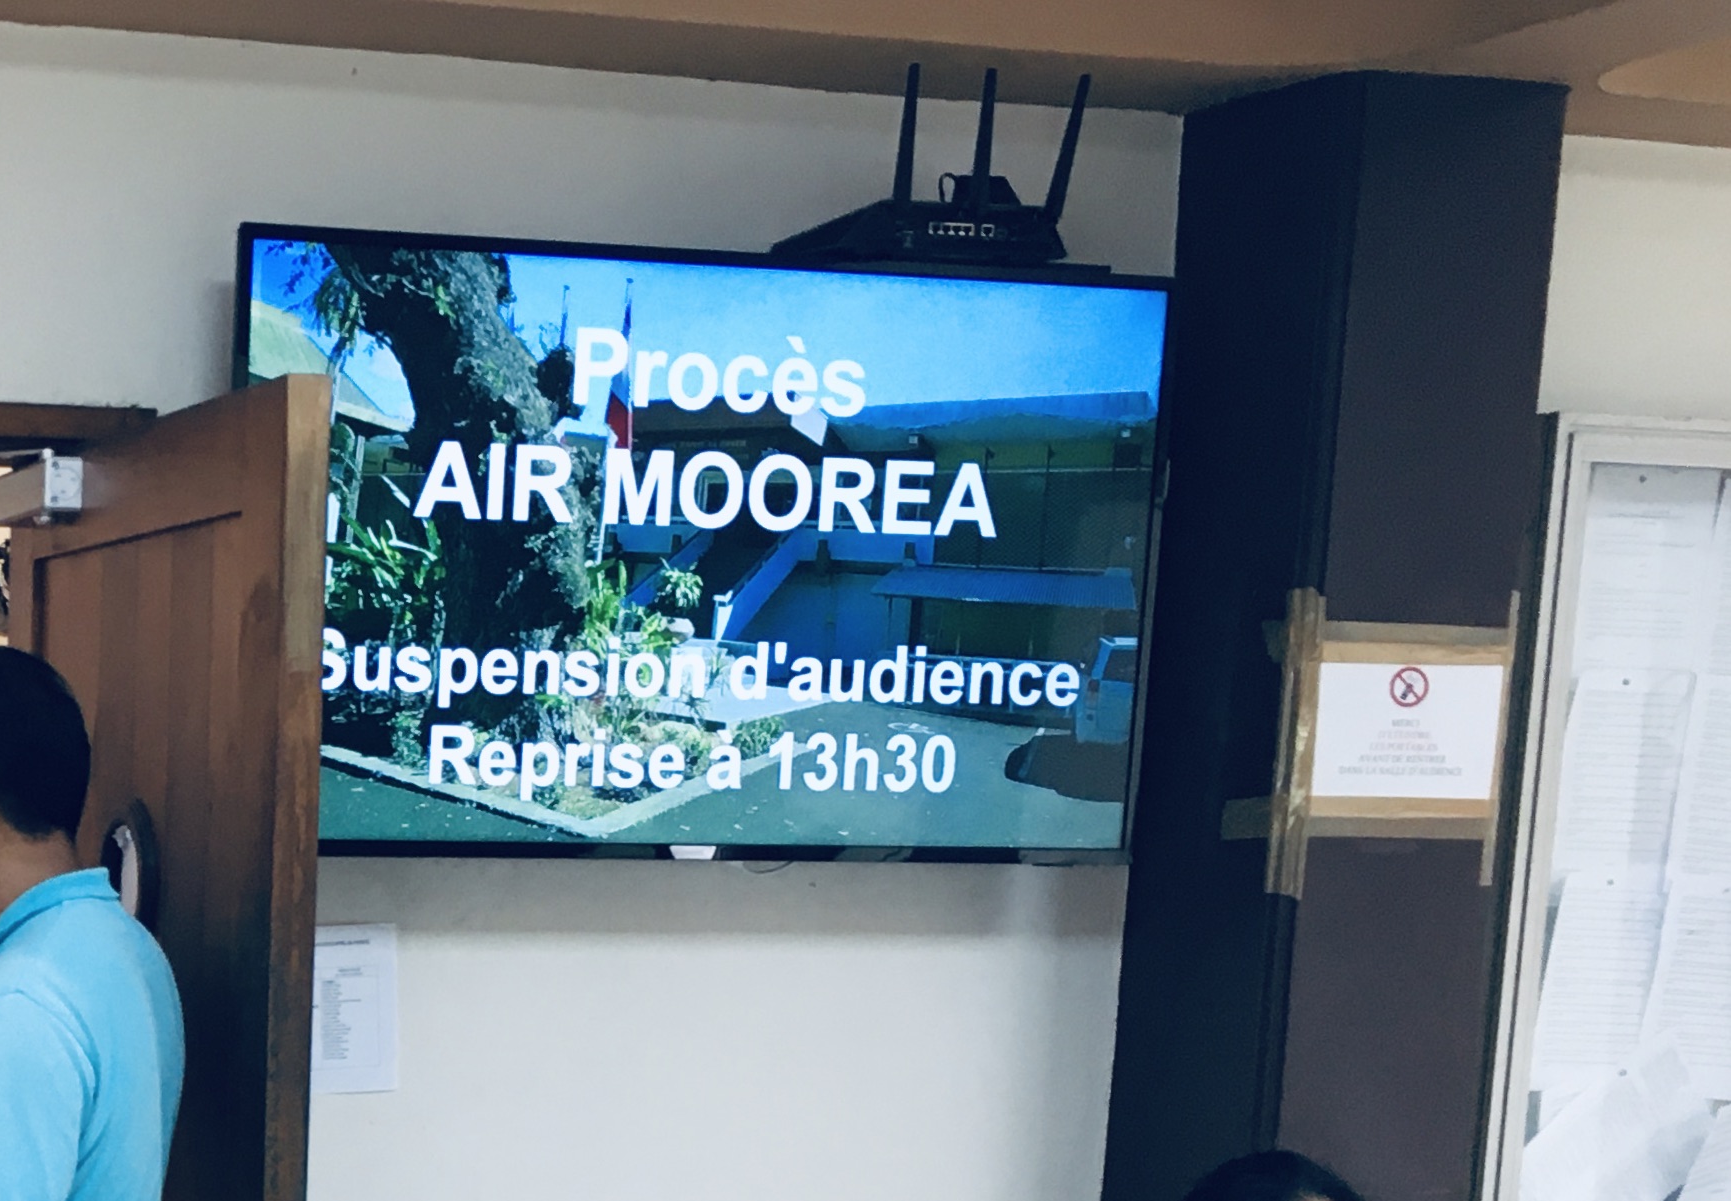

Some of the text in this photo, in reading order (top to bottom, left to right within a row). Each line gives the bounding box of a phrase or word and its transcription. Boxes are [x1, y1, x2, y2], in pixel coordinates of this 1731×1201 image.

[572, 327, 867, 418] Procès
[413, 440, 997, 538] AIR MOOREA
[322, 627, 1080, 708] Suspension d'audience
[427, 724, 956, 801] Reprise à 13h30
